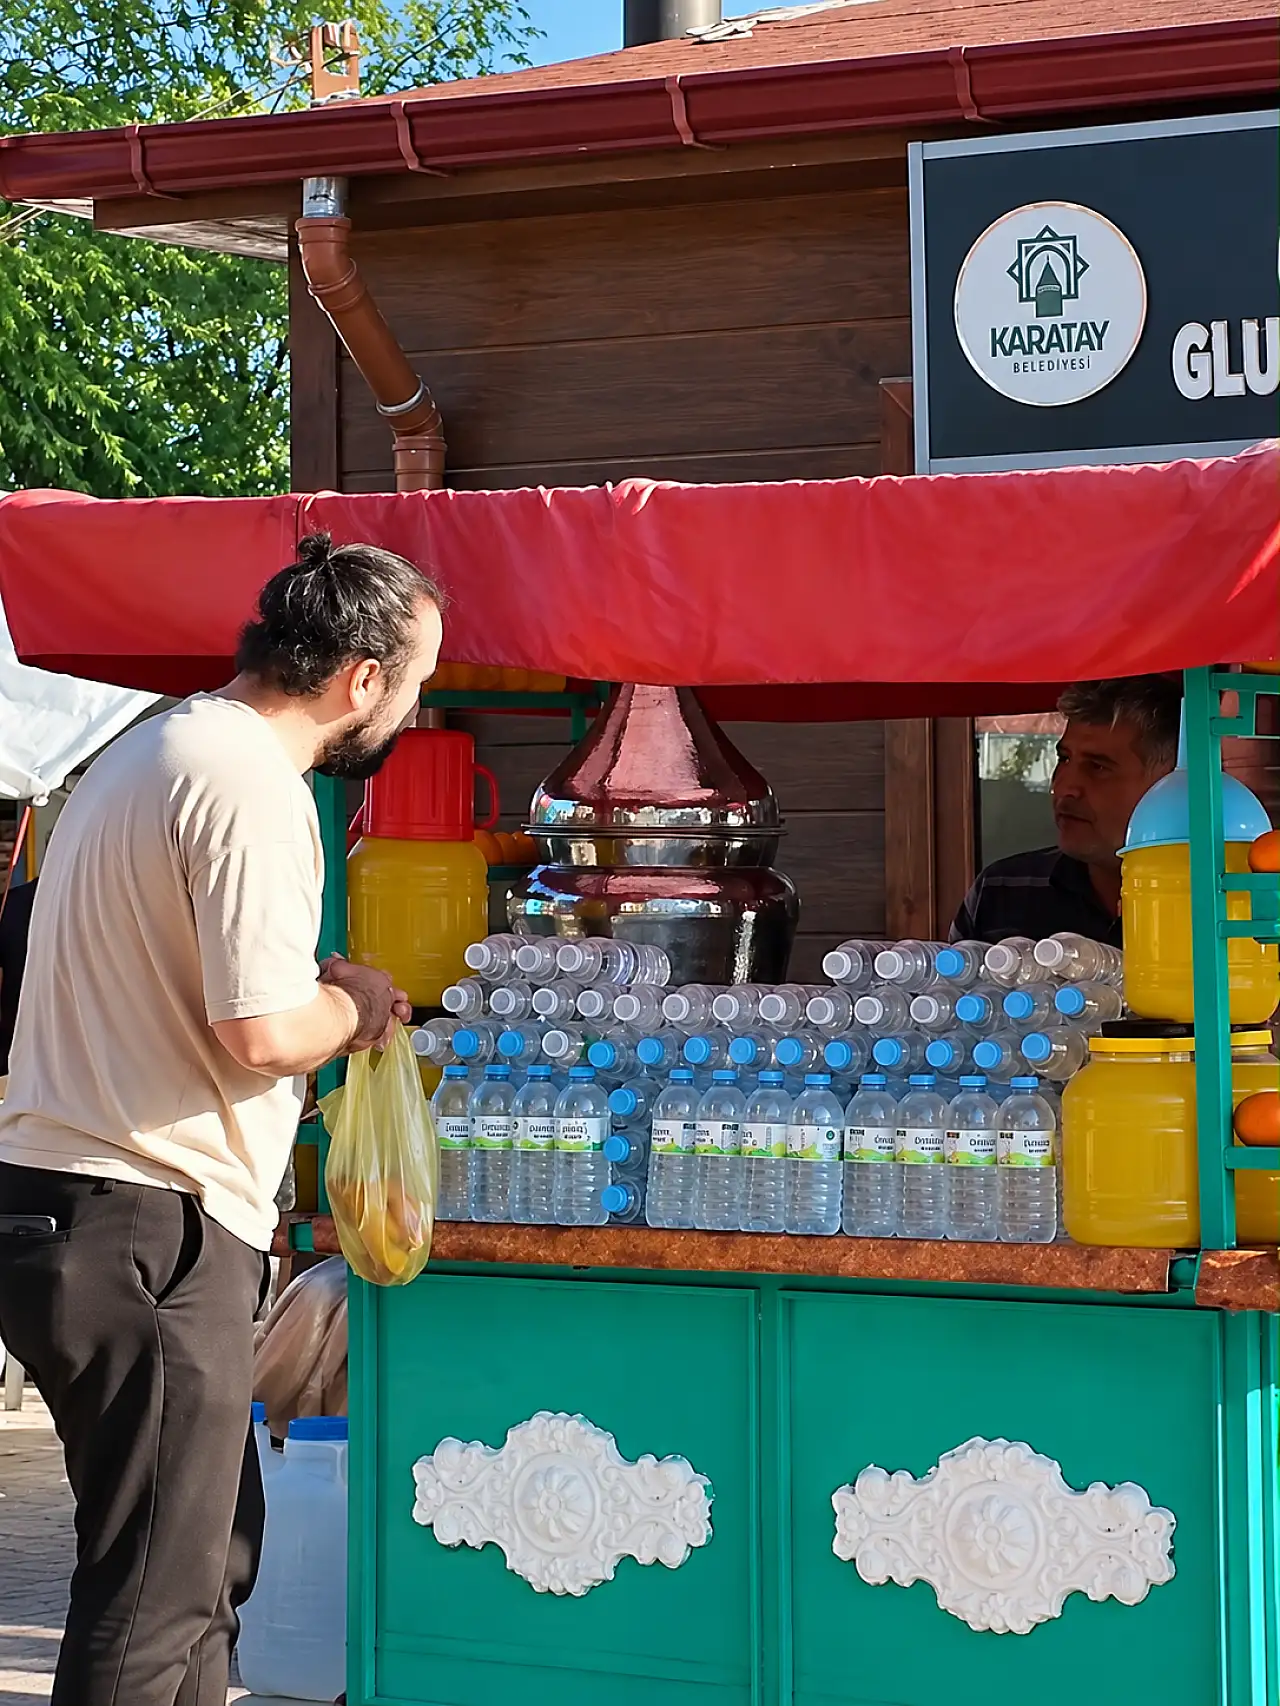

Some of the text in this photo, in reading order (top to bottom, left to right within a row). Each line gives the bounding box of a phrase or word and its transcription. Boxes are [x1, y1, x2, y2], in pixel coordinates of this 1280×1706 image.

[990, 320, 1110, 357] KARATAY
[1013, 355, 1090, 373] BELEDİYESİ
[1172, 317, 1280, 400] GLU
